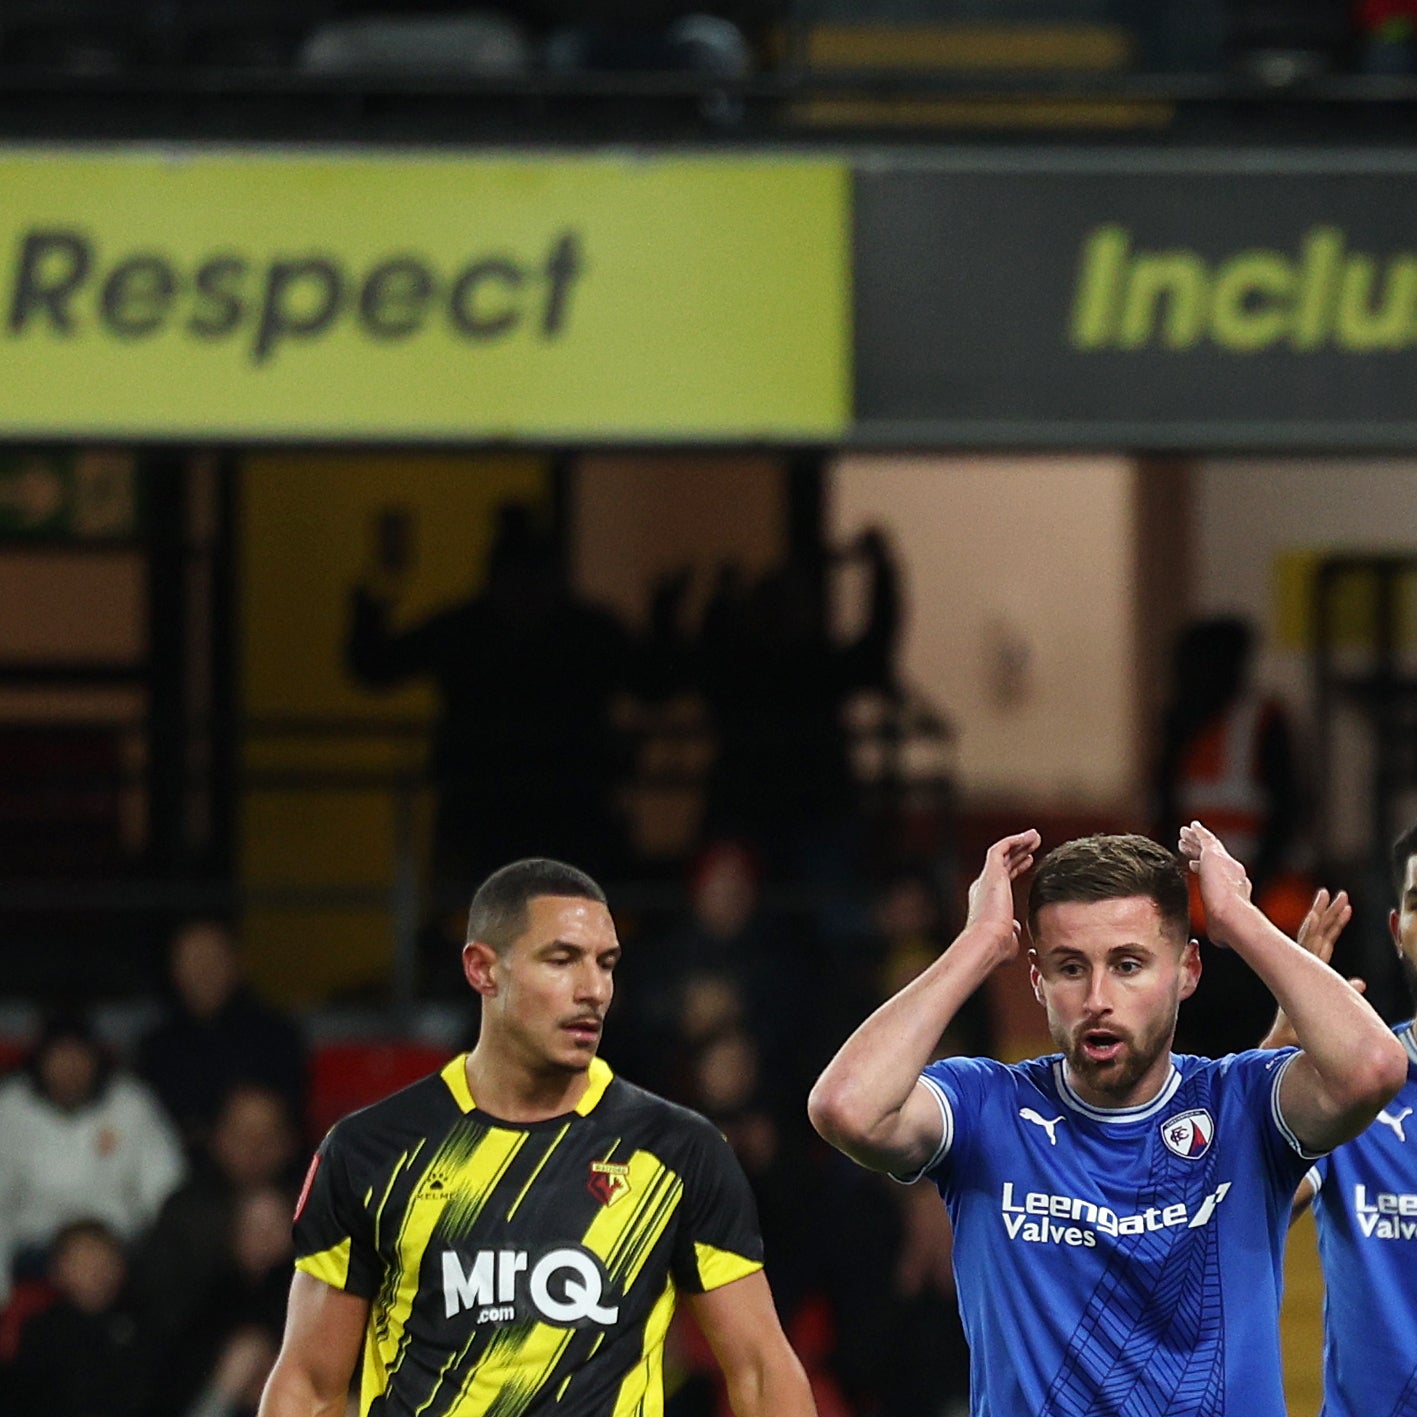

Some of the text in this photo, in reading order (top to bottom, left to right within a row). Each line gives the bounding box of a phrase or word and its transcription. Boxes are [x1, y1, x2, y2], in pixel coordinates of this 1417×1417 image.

[6, 227, 587, 367] Respect
[1002, 1182, 1188, 1238] Leengate
[1002, 1213, 1097, 1248] Valves
[441, 1248, 619, 1326] MrQ
[477, 1306, 515, 1324] .com
